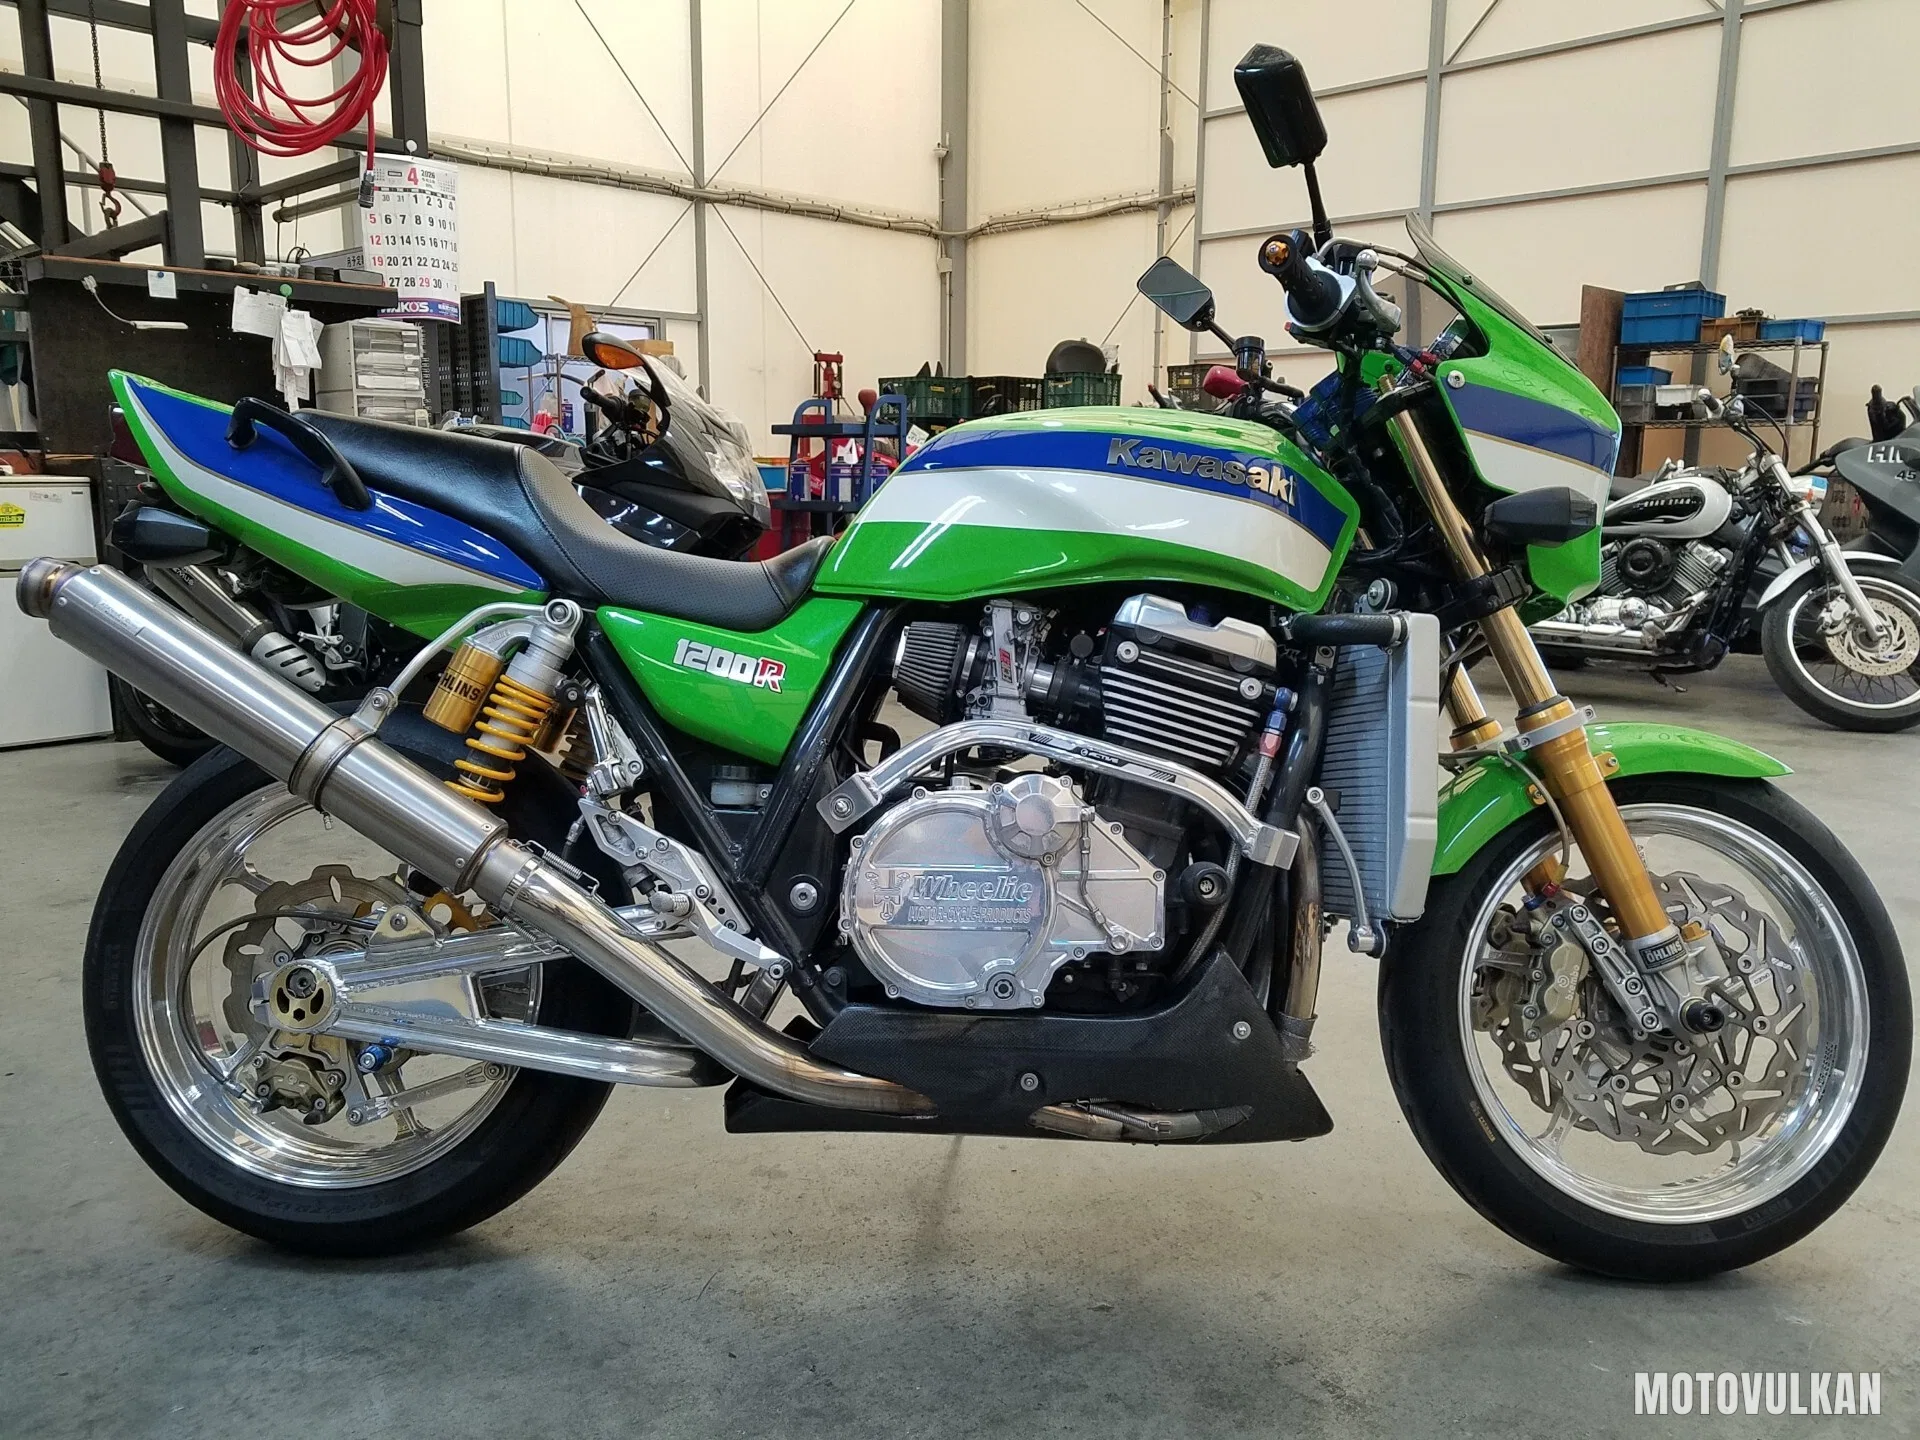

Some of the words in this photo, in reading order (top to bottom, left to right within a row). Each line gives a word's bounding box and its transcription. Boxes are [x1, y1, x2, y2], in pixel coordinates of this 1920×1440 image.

[407, 167, 419, 186] 4
[413, 194, 418, 204] 1
[426, 196, 432, 206] 2
[437, 197, 443, 209] 3
[448, 200, 454, 211] 4
[369, 213, 377, 224] 5
[384, 214, 392, 225] 6
[400, 214, 406, 225] 7
[414, 214, 422, 225] 8
[428, 215, 435, 227] 9
[438, 218, 447, 230] 10
[448, 221, 456, 232] 11
[370, 235, 382, 245] 12
[385, 235, 397, 246] 13
[400, 235, 411, 246] 14
[415, 235, 426, 246] 15
[429, 237, 438, 248] 16
[440, 239, 448, 250] 17
[449, 241, 458, 253] 18
[372, 256, 384, 267] 19
[387, 256, 399, 267] 20
[402, 256, 413, 267] 21
[416, 256, 428, 267] 22
[430, 257, 440, 269] 23
[442, 259, 450, 271] 24
[451, 262, 458, 273] 25
[389, 277, 400, 288] 27
[404, 276, 416, 288] 28
[419, 277, 430, 288] 29
[432, 278, 442, 289] 30
[1106, 437, 1297, 507] Kawasaki
[1894, 469, 1920, 482] 45
[171, 566, 194, 586] EMUS
[440, 672, 481, 702] HLINS
[909, 874, 1034, 902] Wheelie
[1564, 964, 1581, 1001] brembo
